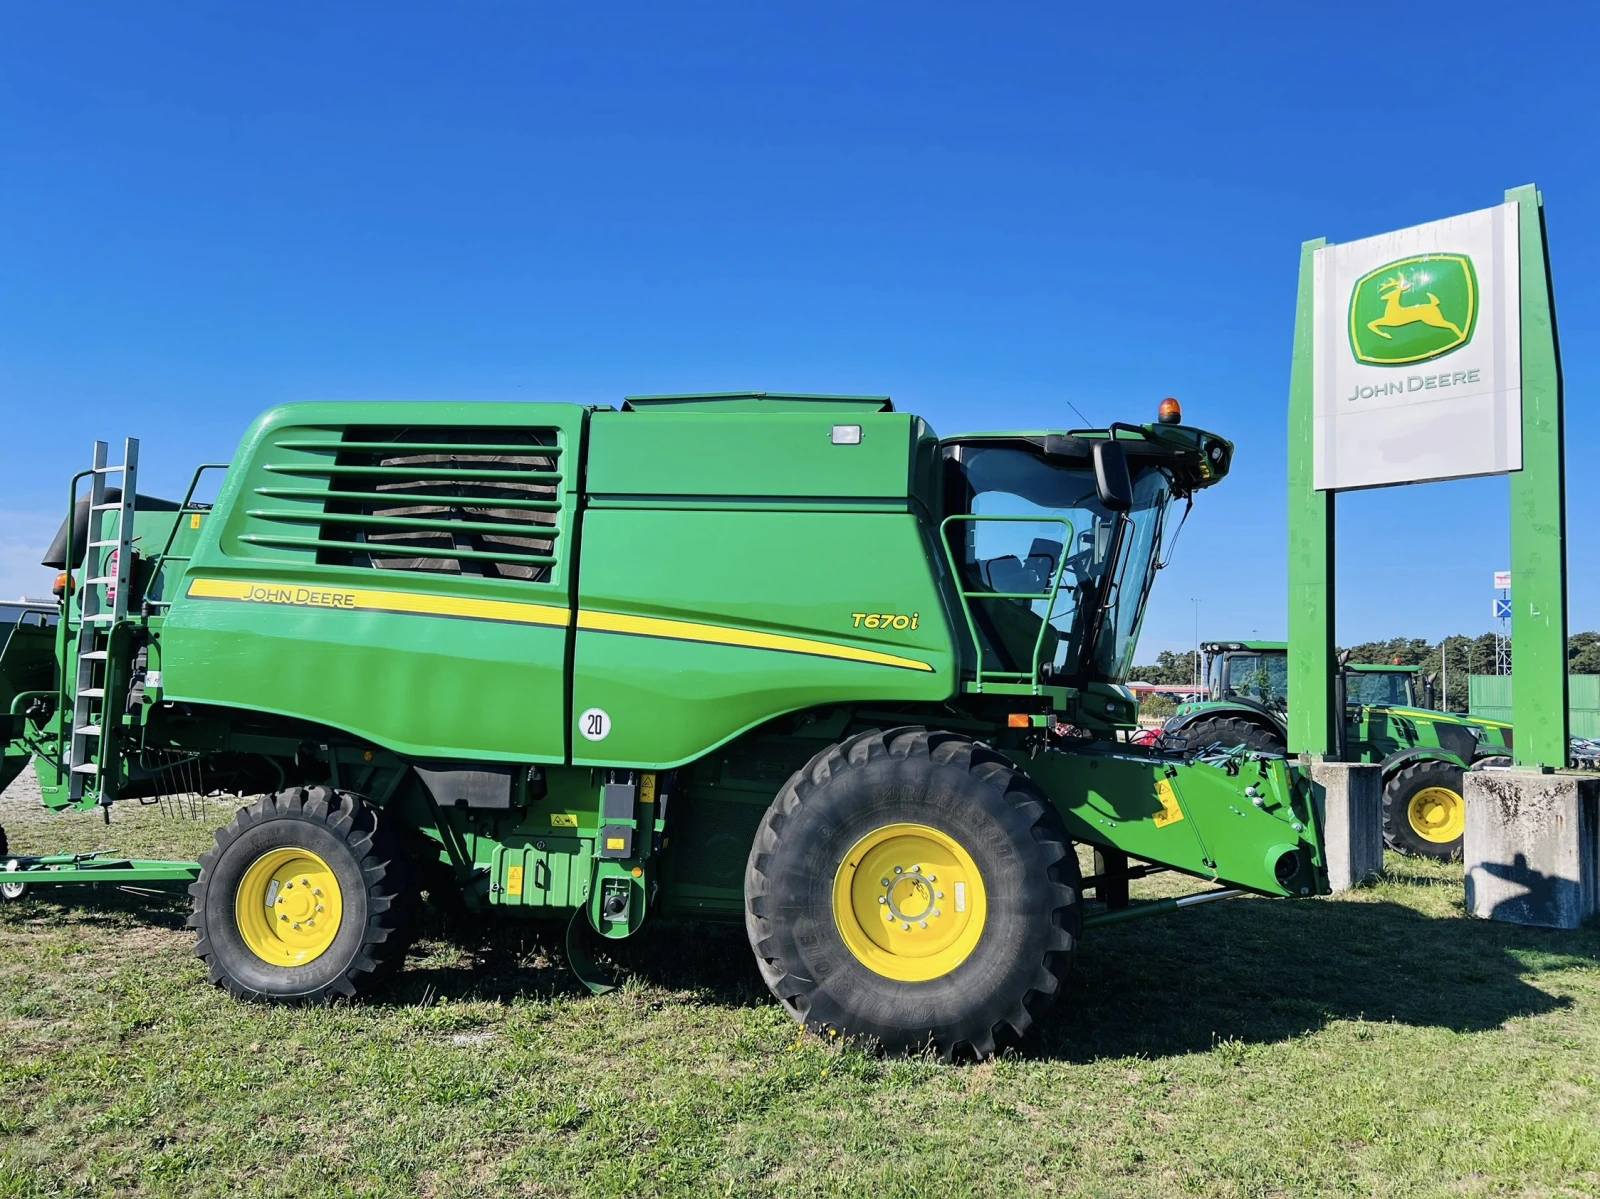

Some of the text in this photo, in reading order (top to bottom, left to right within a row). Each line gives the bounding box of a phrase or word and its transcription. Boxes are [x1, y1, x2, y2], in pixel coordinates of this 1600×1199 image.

[1347, 369, 1480, 401] JOHN DEERE
[243, 585, 355, 605] JOHN DEERE
[851, 612, 919, 630] T670i
[587, 714, 602, 735] 20
